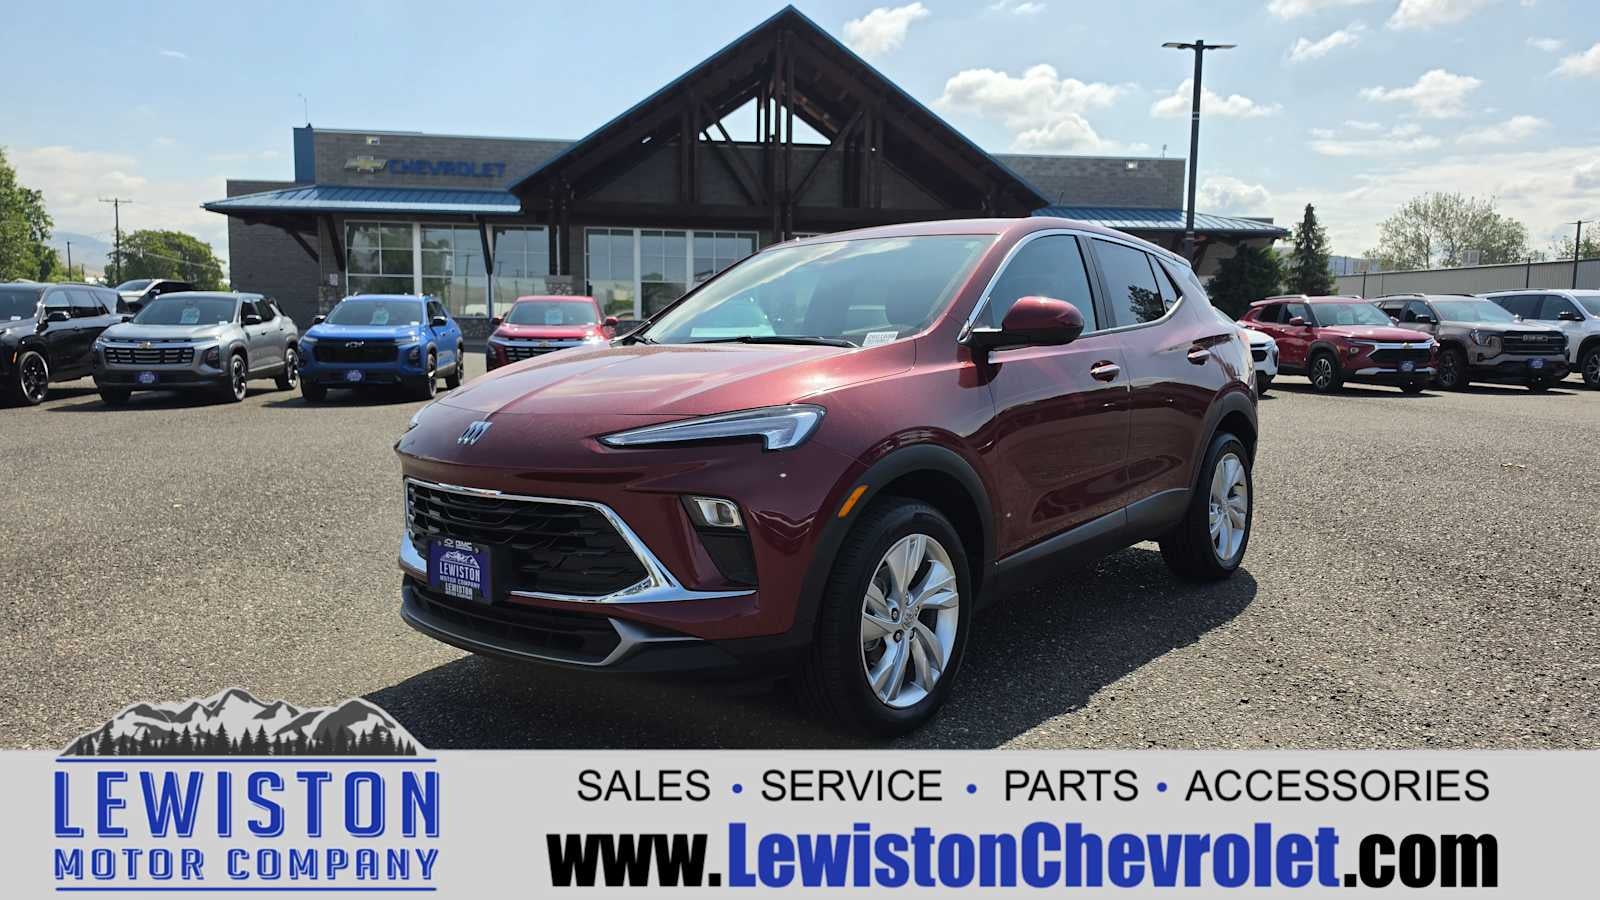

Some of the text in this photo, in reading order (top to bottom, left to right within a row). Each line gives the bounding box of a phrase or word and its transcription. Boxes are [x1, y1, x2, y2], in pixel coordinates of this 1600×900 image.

[388, 160, 507, 178] CHEVROLET
[439, 561, 481, 582] LEWISTON
[439, 575, 481, 589] MOTOR COMPANY
[445, 582, 473, 596] LEWISTON
